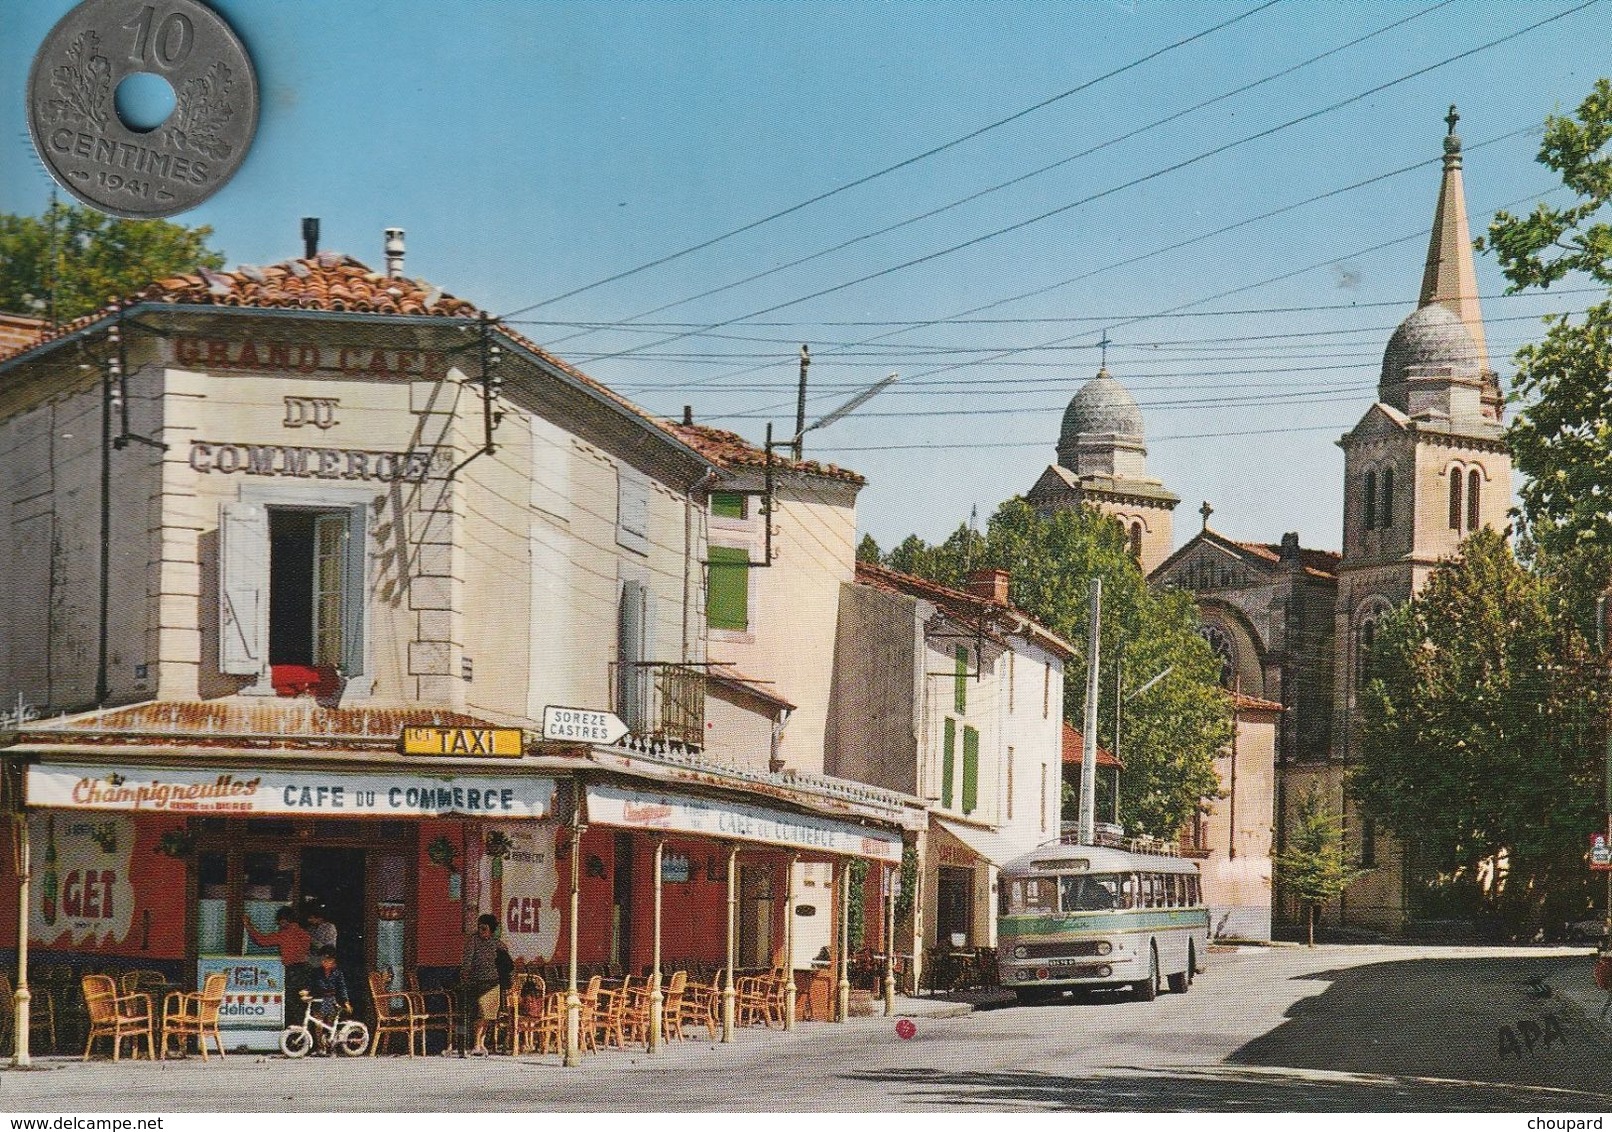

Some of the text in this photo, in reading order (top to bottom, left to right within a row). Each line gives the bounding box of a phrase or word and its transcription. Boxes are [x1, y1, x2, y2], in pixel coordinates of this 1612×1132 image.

[123, 5, 194, 70] 10
[50, 127, 208, 185] CENTIMES
[99, 171, 150, 197] 1941
[173, 336, 321, 374] GRAND
[283, 396, 340, 430] DU
[188, 441, 430, 484] COMMERCE
[550, 722, 608, 740] CASTRES
[554, 710, 606, 726] SOREZE
[72, 774, 262, 810] Champigneulles
[284, 785, 513, 811] CAFE DU COMMERCE
[62, 869, 117, 919] GET
[507, 897, 542, 934] GET
